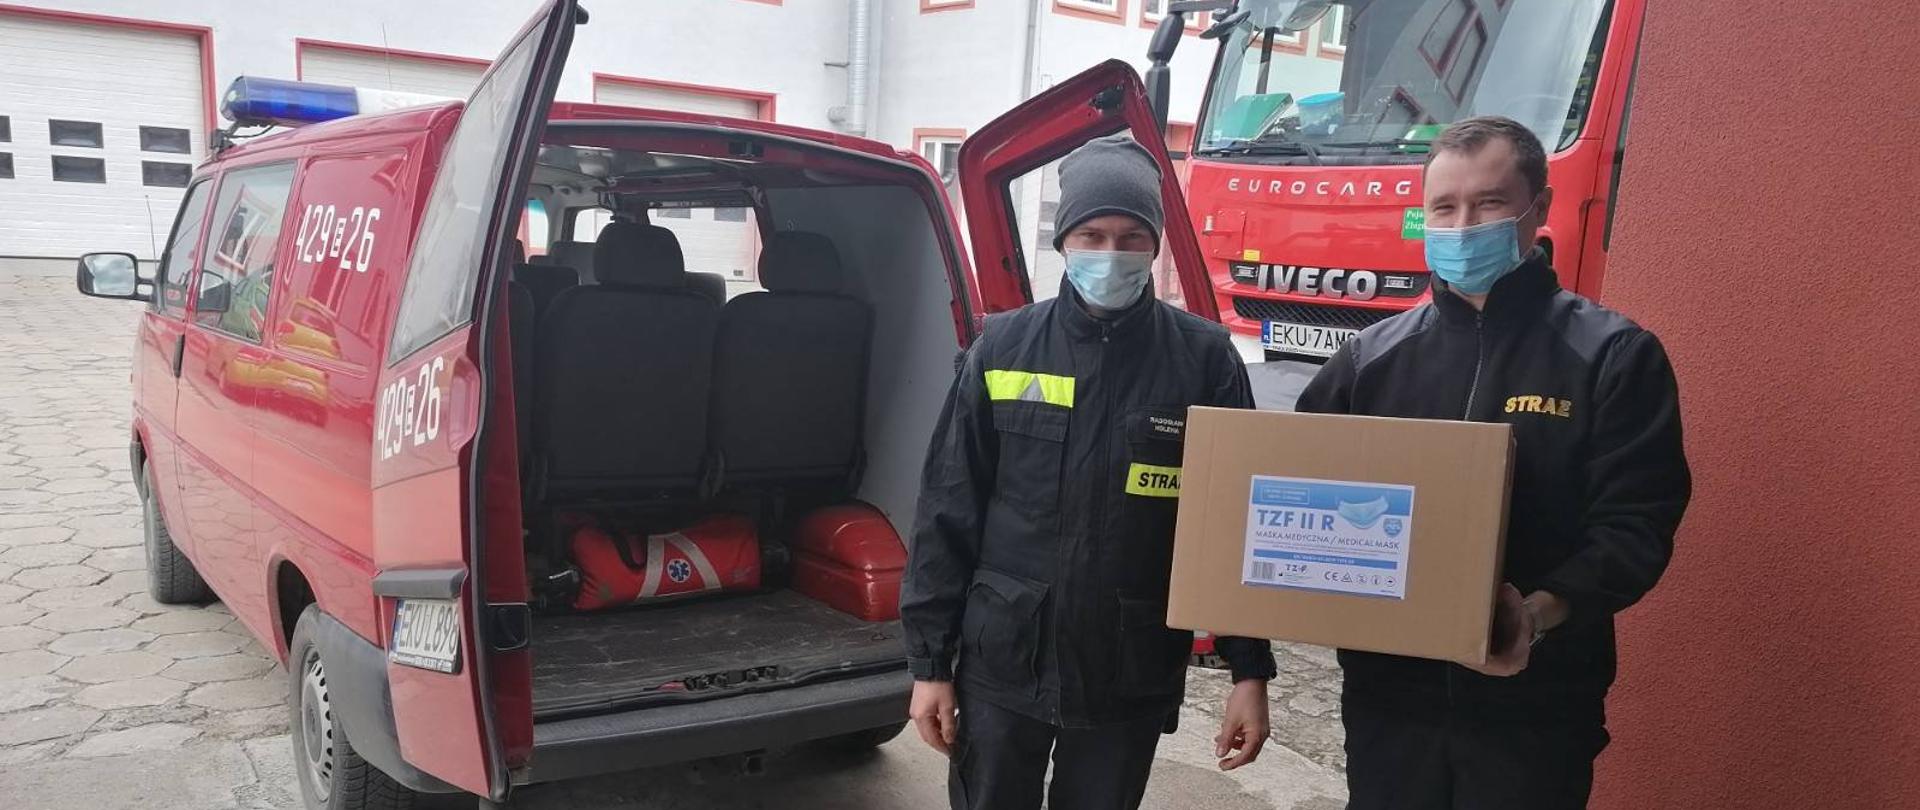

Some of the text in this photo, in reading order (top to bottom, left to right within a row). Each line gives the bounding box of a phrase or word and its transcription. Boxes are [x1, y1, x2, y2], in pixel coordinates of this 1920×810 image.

[1228, 178, 1412, 196] EUROCARG
[1257, 264, 1377, 300] IVECO
[1272, 323, 1308, 347] EKU
[1313, 329, 1355, 352] 7AM
[1138, 472, 1181, 489] STRA
[1257, 509, 1335, 531] TZF II R
[1256, 531, 1282, 540] MASKA
[1284, 532, 1329, 543] MEDYCZNA
[1338, 538, 1374, 547] MEDICAL
[1376, 540, 1400, 549] MASK
[400, 603, 429, 649] EKU
